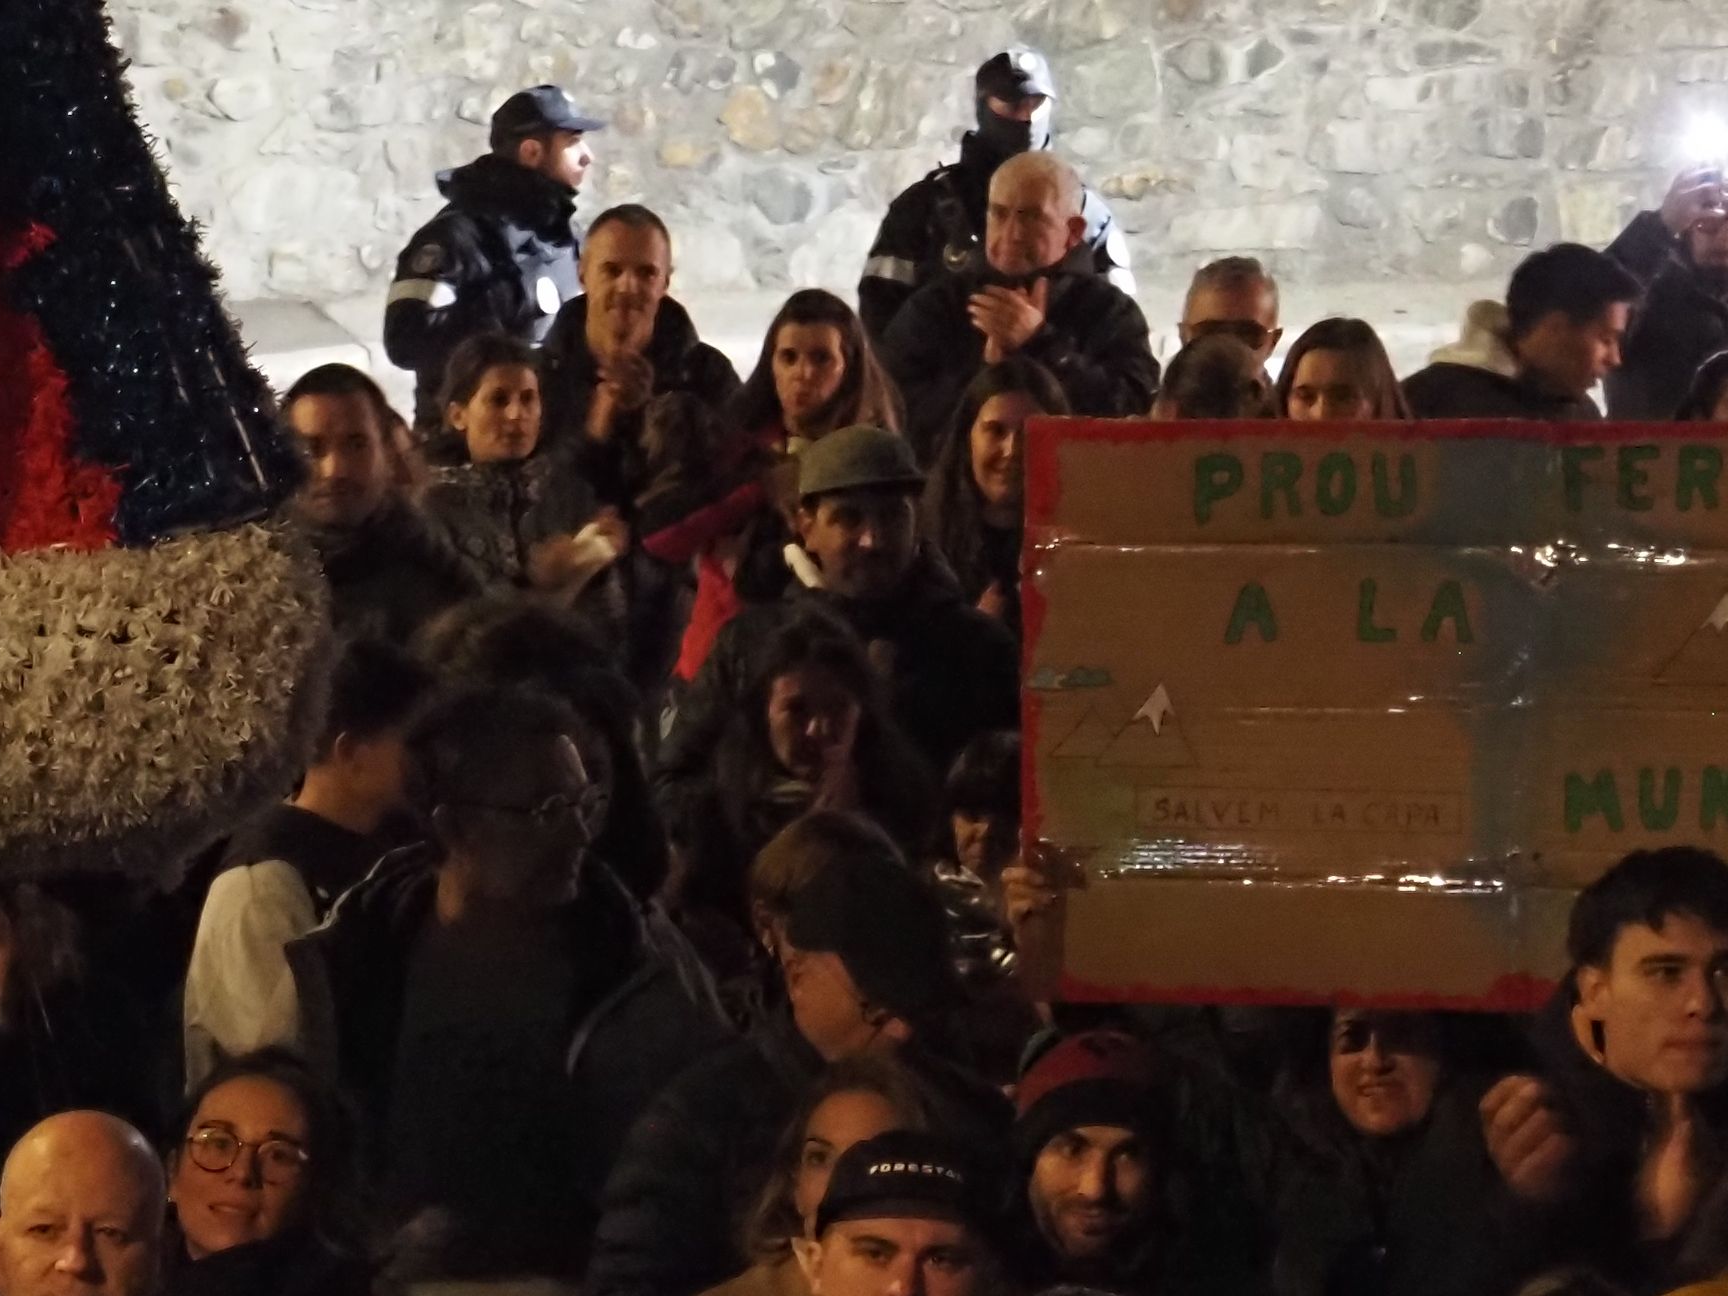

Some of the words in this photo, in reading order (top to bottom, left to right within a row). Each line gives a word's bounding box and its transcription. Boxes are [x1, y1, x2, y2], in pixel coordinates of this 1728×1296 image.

[1192, 451, 1419, 525] PROU
[1562, 444, 1726, 513] FER
[1223, 580, 1281, 646] A
[1357, 576, 1476, 645] LA
[1152, 796, 1282, 826] SALVEM
[1312, 795, 1348, 824] LA
[1362, 800, 1442, 828] CAPA
